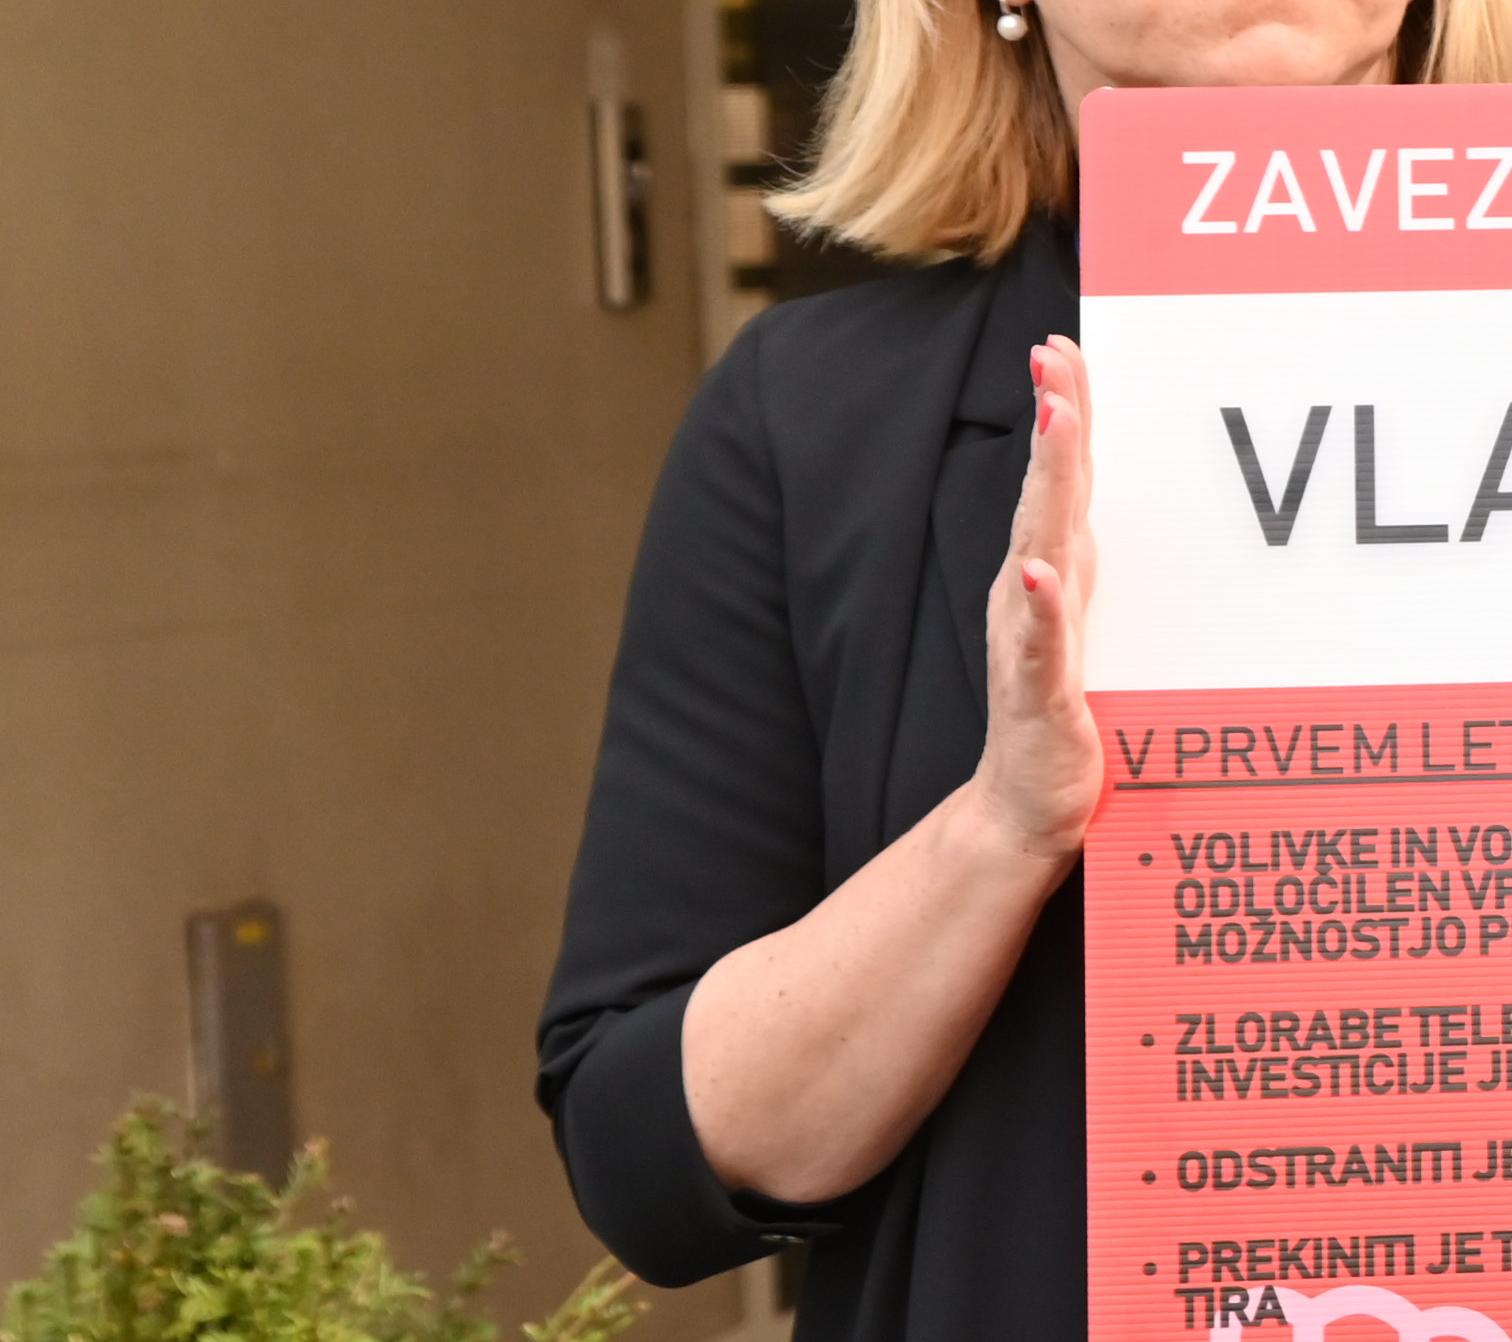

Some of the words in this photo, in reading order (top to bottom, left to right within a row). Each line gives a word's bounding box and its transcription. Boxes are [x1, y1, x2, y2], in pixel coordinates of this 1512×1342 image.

[1118, 729, 1153, 778] V
[1175, 724, 1399, 777] PRVEM
[1173, 829, 1378, 874] VOLIVKE
[1395, 828, 1437, 867] IN
[1176, 865, 1450, 918] ODLOČILEN
[1176, 1009, 1402, 1054] ZLORABE
[1178, 1051, 1467, 1100] INVESTICIJE
[1179, 1143, 1461, 1191] ODSTRANITI
[1180, 1235, 1414, 1283] PREKINITI
[1427, 1232, 1483, 1274] JE
[1176, 1286, 1287, 1328] TIRA
